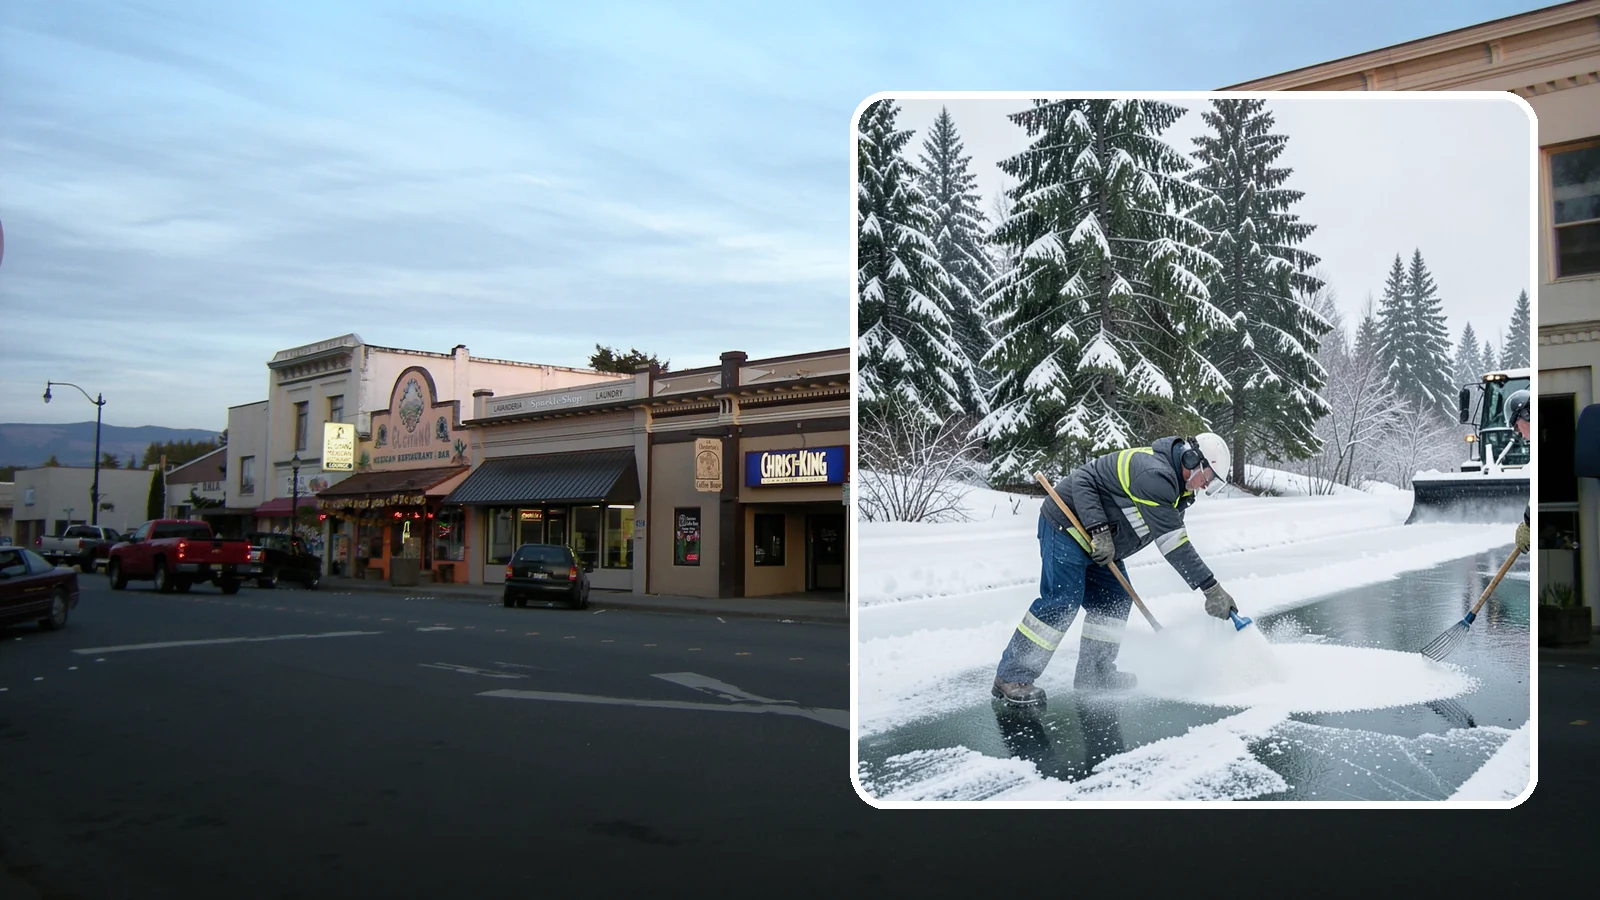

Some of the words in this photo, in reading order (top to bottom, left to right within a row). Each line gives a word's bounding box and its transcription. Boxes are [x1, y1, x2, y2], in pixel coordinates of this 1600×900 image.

[493, 402, 522, 412] LAVANDERIA
[531, 399, 560, 409] Sparkle
[561, 395, 582, 406] Shop
[595, 389, 623, 400] LAUNDRY
[374, 456, 396, 464] MEXICAN
[398, 452, 433, 462] RESTAURANT
[438, 450, 450, 459] BAR
[761, 452, 797, 478] CHRIST
[799, 450, 827, 476] KING
[696, 480, 709, 489] Coffee
